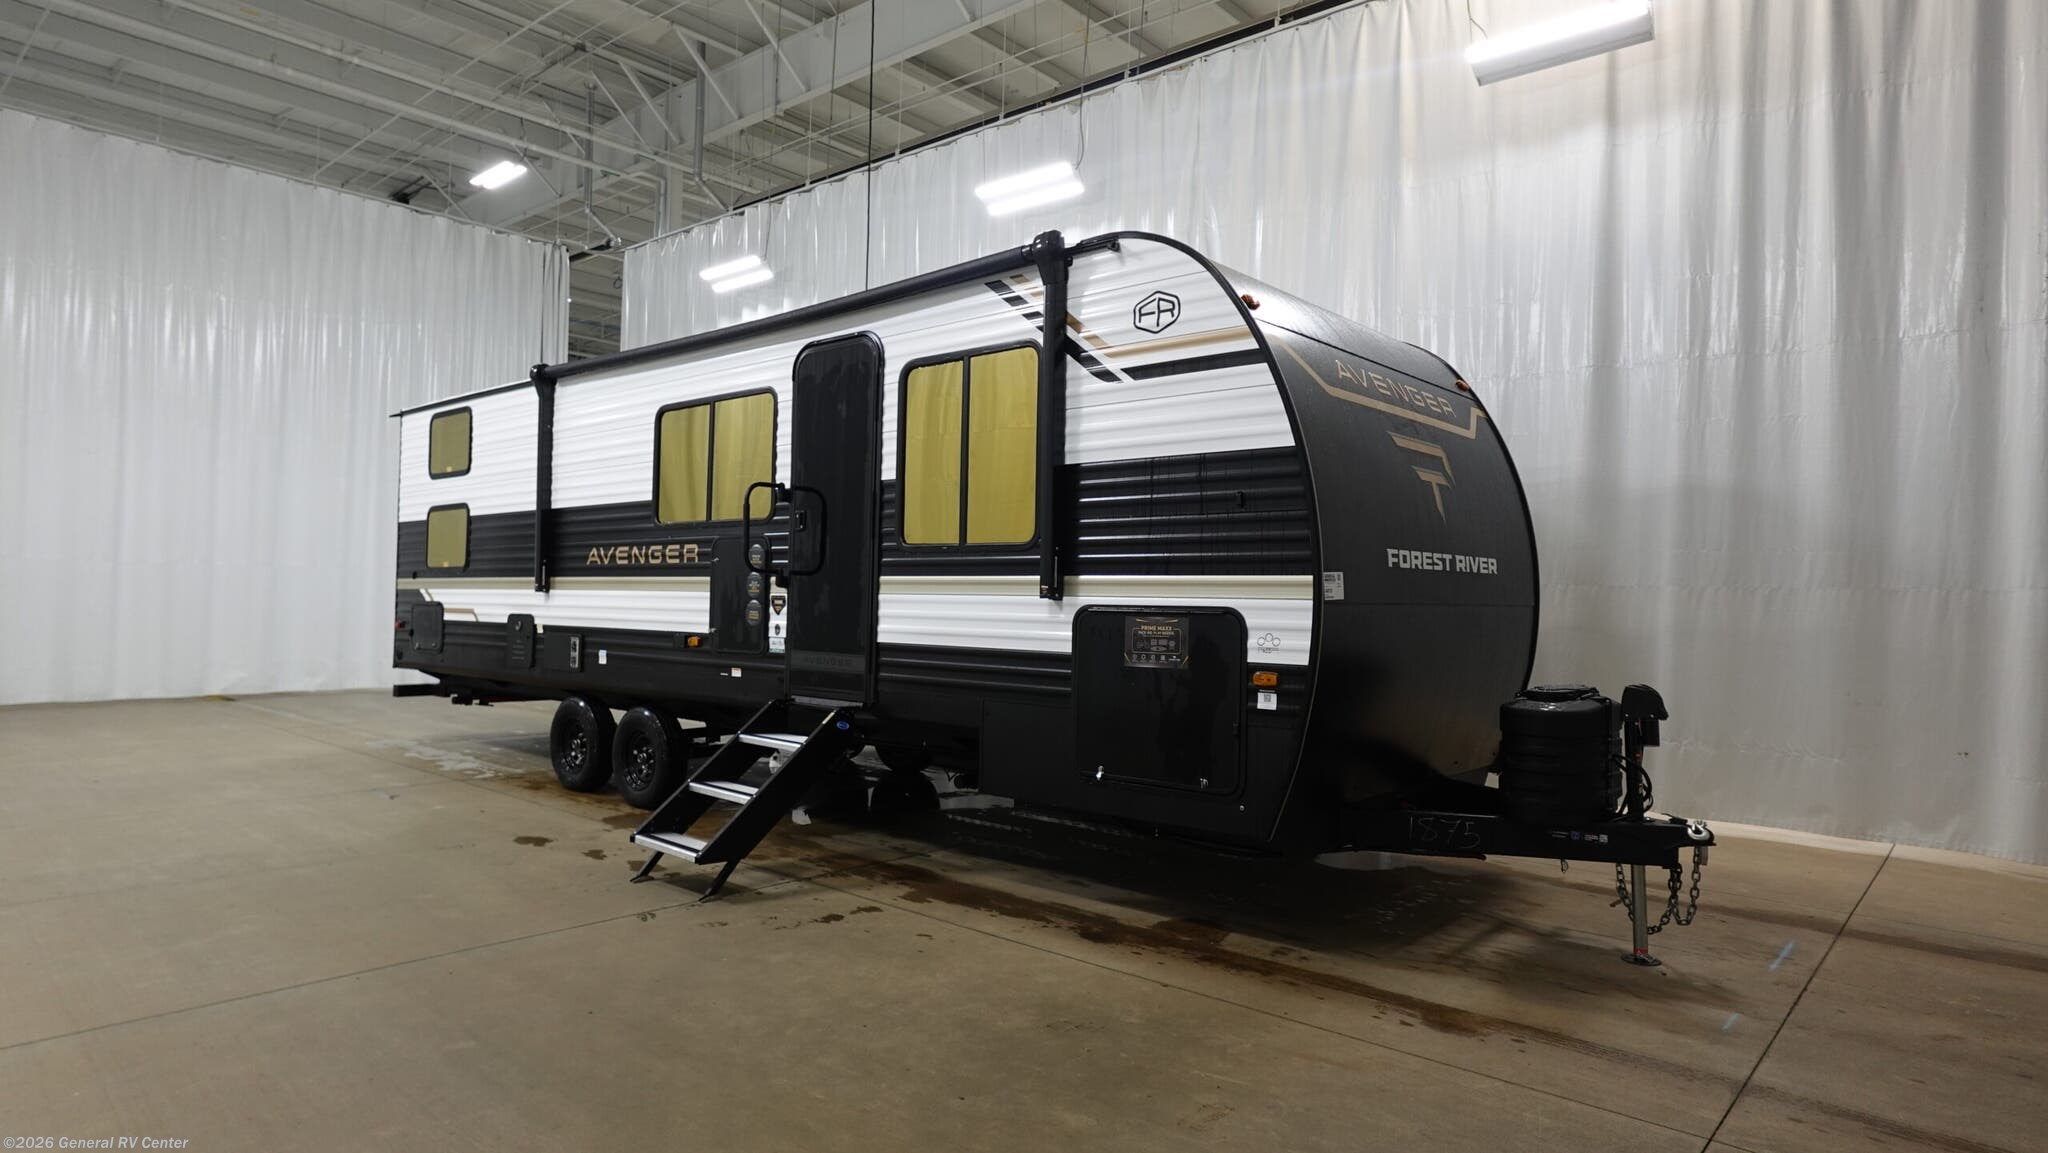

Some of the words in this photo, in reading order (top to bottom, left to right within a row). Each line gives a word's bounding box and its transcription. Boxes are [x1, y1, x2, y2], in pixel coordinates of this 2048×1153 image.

[1335, 359, 1456, 418] AVENGER
[586, 543, 700, 566] AVENGER
[1386, 548, 1453, 571] FOREST
[1455, 553, 1498, 575] RIVER
[1408, 815, 1481, 849] 1875
